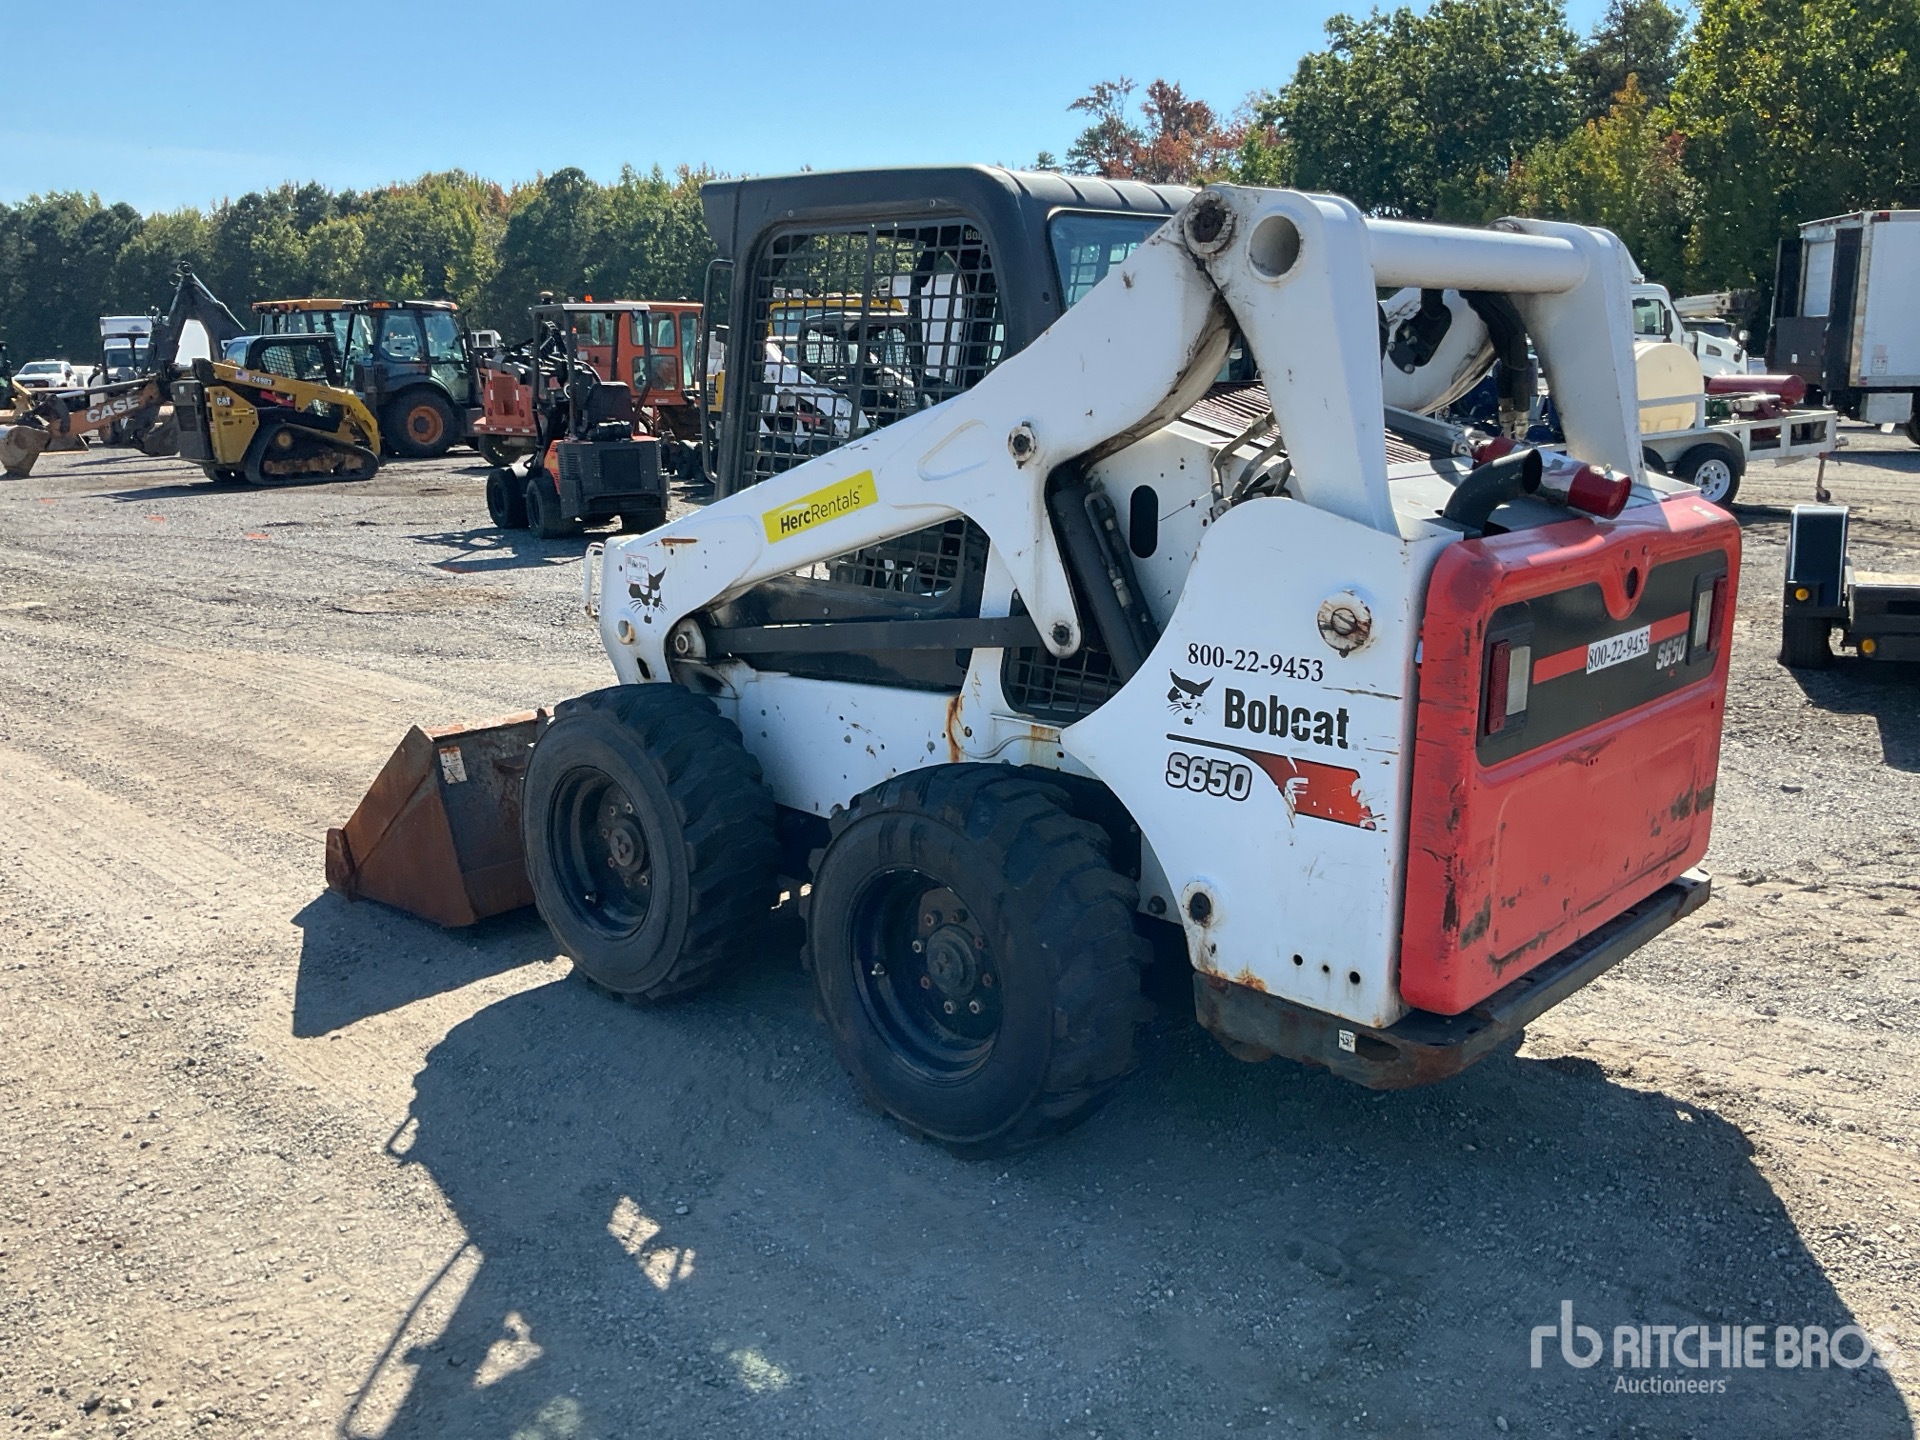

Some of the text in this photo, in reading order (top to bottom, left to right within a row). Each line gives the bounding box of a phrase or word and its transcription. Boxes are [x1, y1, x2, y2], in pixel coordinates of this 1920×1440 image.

[86, 395, 139, 423] CASE
[216, 396, 231, 407] CAT
[1187, 643, 1324, 682] 800-22-9453
[1587, 630, 1650, 671] 800-22-9453
[1655, 634, 1687, 671] S650
[1224, 688, 1350, 750] Bobcat
[1166, 752, 1252, 801] S650
